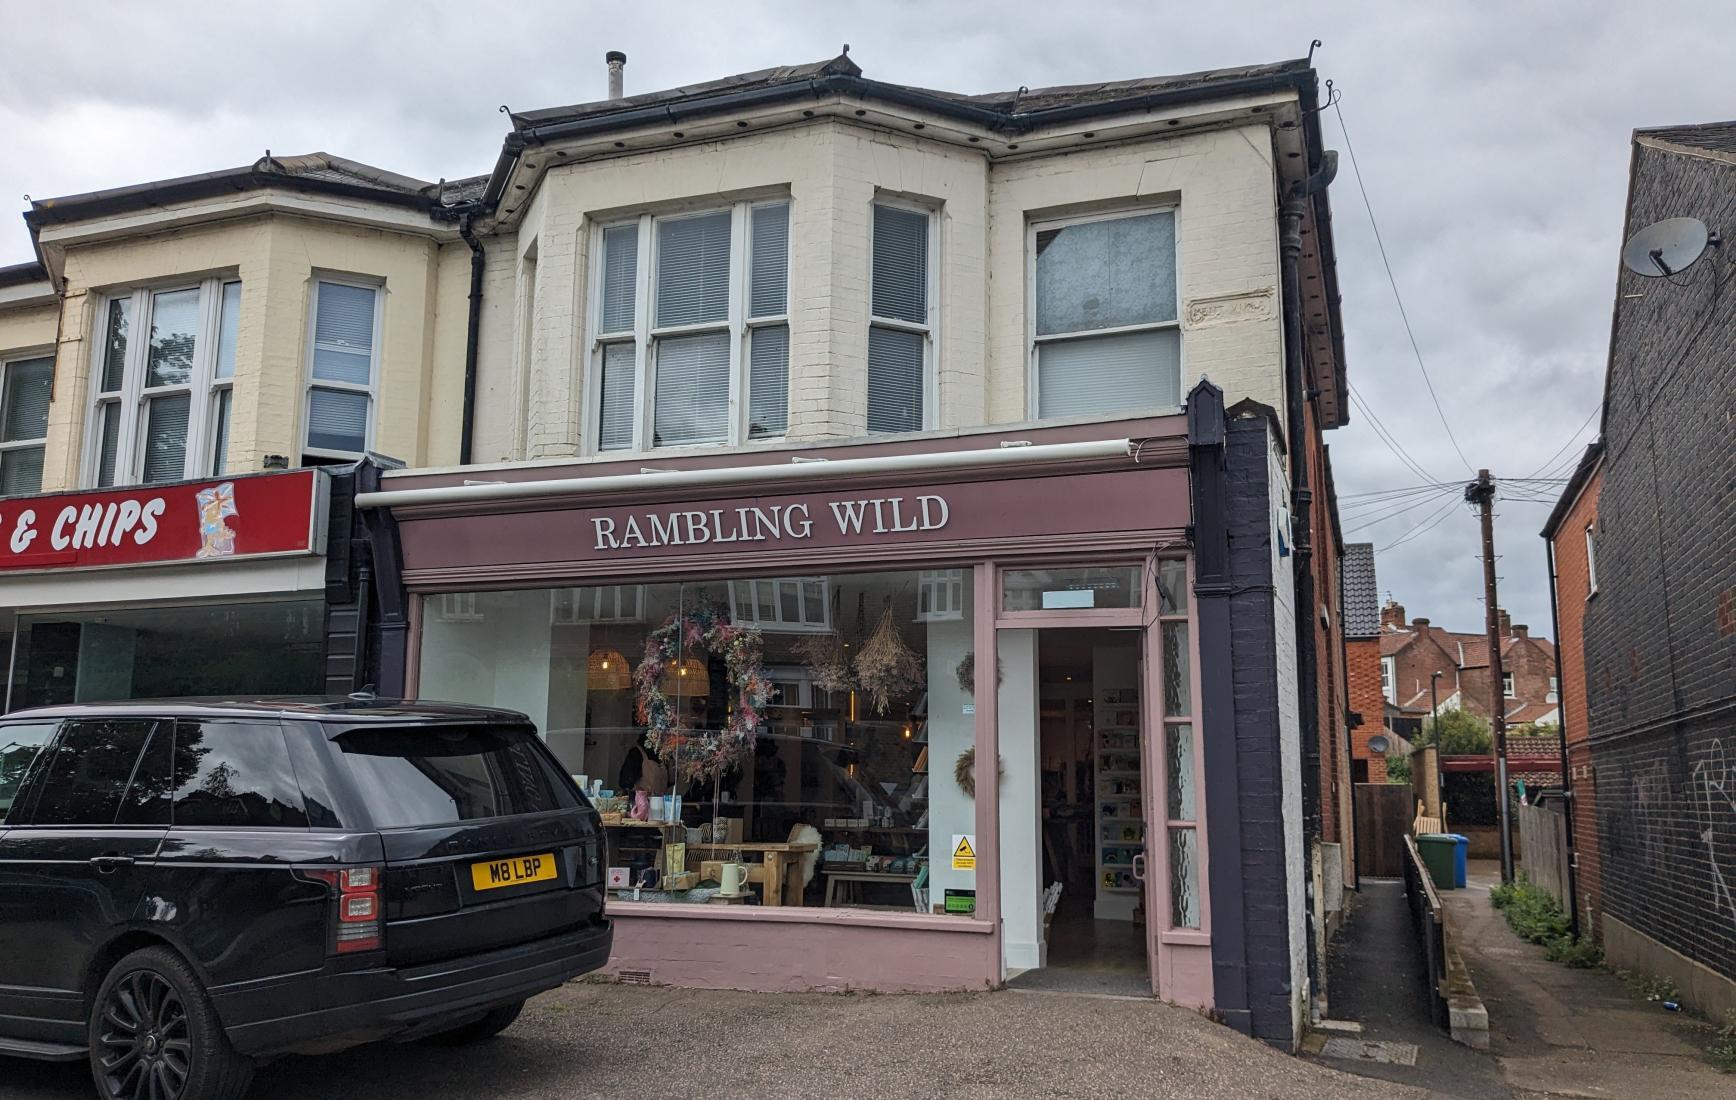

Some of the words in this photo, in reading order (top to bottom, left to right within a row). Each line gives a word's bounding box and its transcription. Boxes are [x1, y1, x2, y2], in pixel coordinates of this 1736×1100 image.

[10, 509, 38, 554] &
[50, 498, 166, 551] CHIPS
[590, 503, 813, 549] RAMBLING
[829, 494, 949, 535] WILD
[489, 862, 511, 883] M8
[513, 857, 542, 880] LBP
